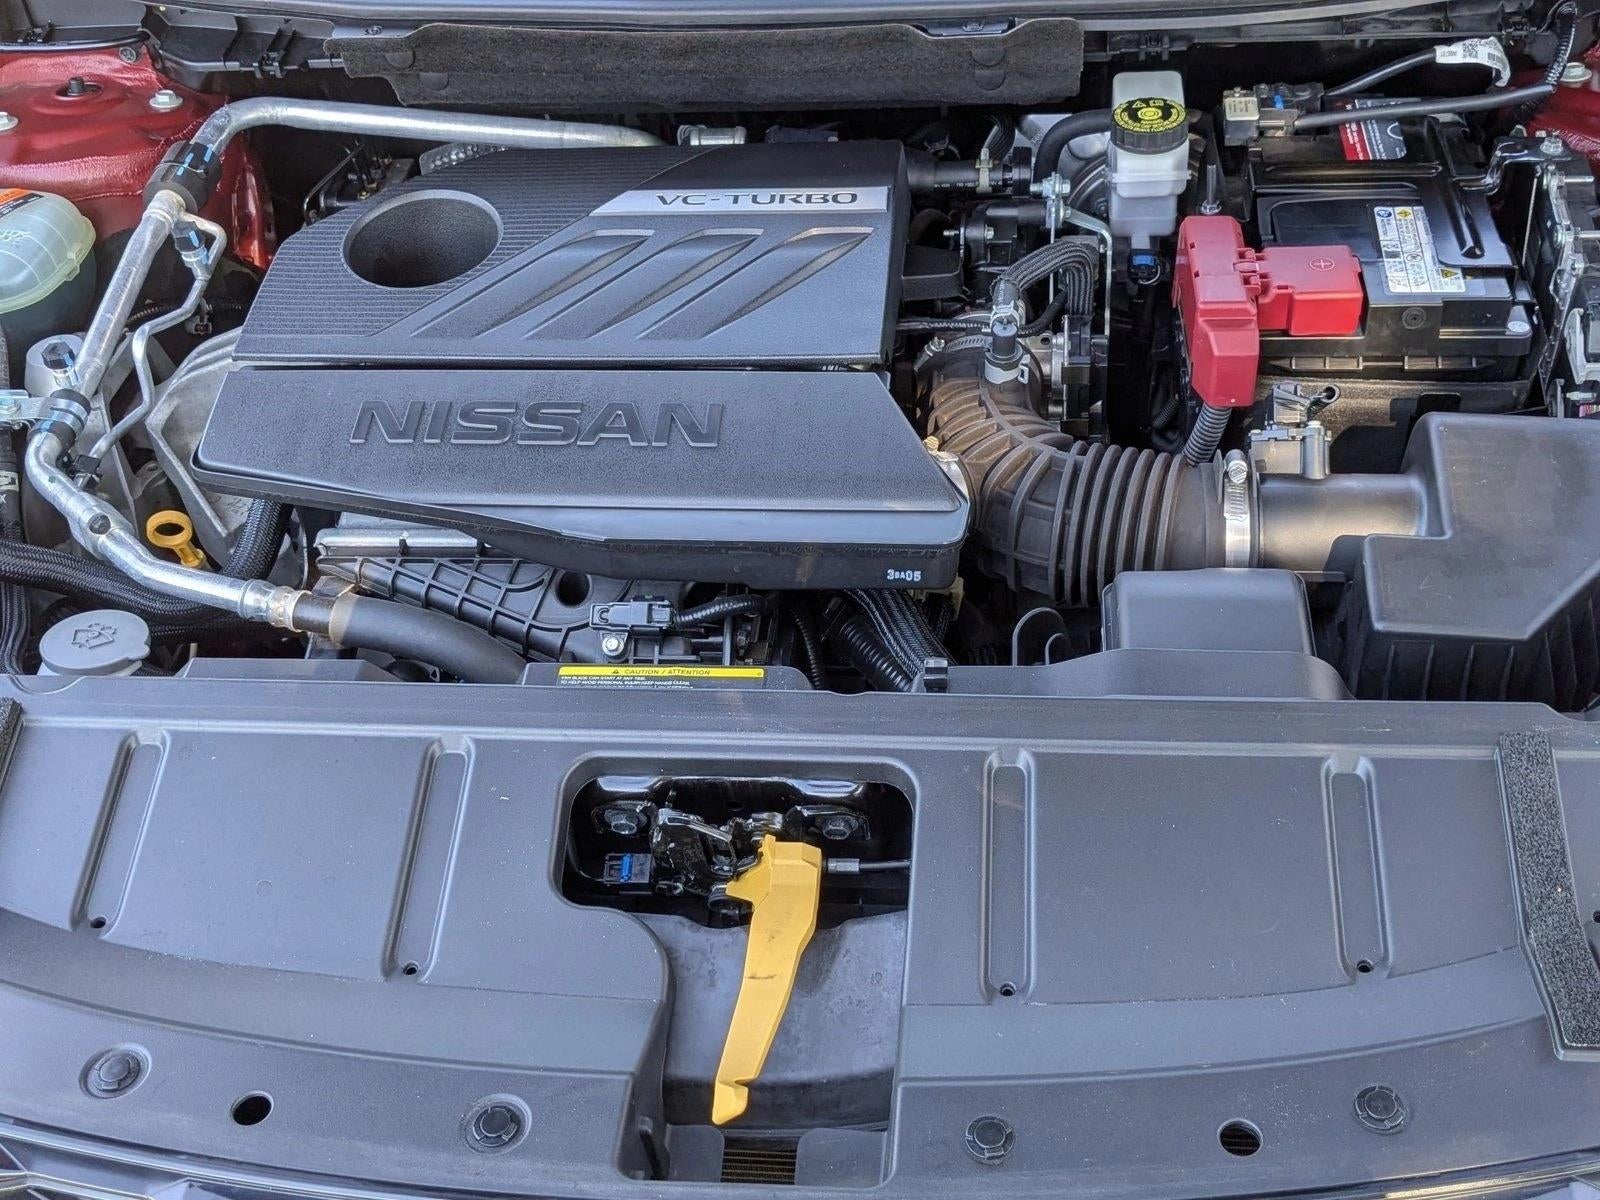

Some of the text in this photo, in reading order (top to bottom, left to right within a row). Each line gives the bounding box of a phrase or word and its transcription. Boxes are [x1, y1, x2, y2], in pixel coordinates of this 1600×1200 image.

[656, 192, 858, 206] VC-TURBO
[349, 400, 724, 447] NISSAN
[667, 668, 711, 676] ATTENTION
